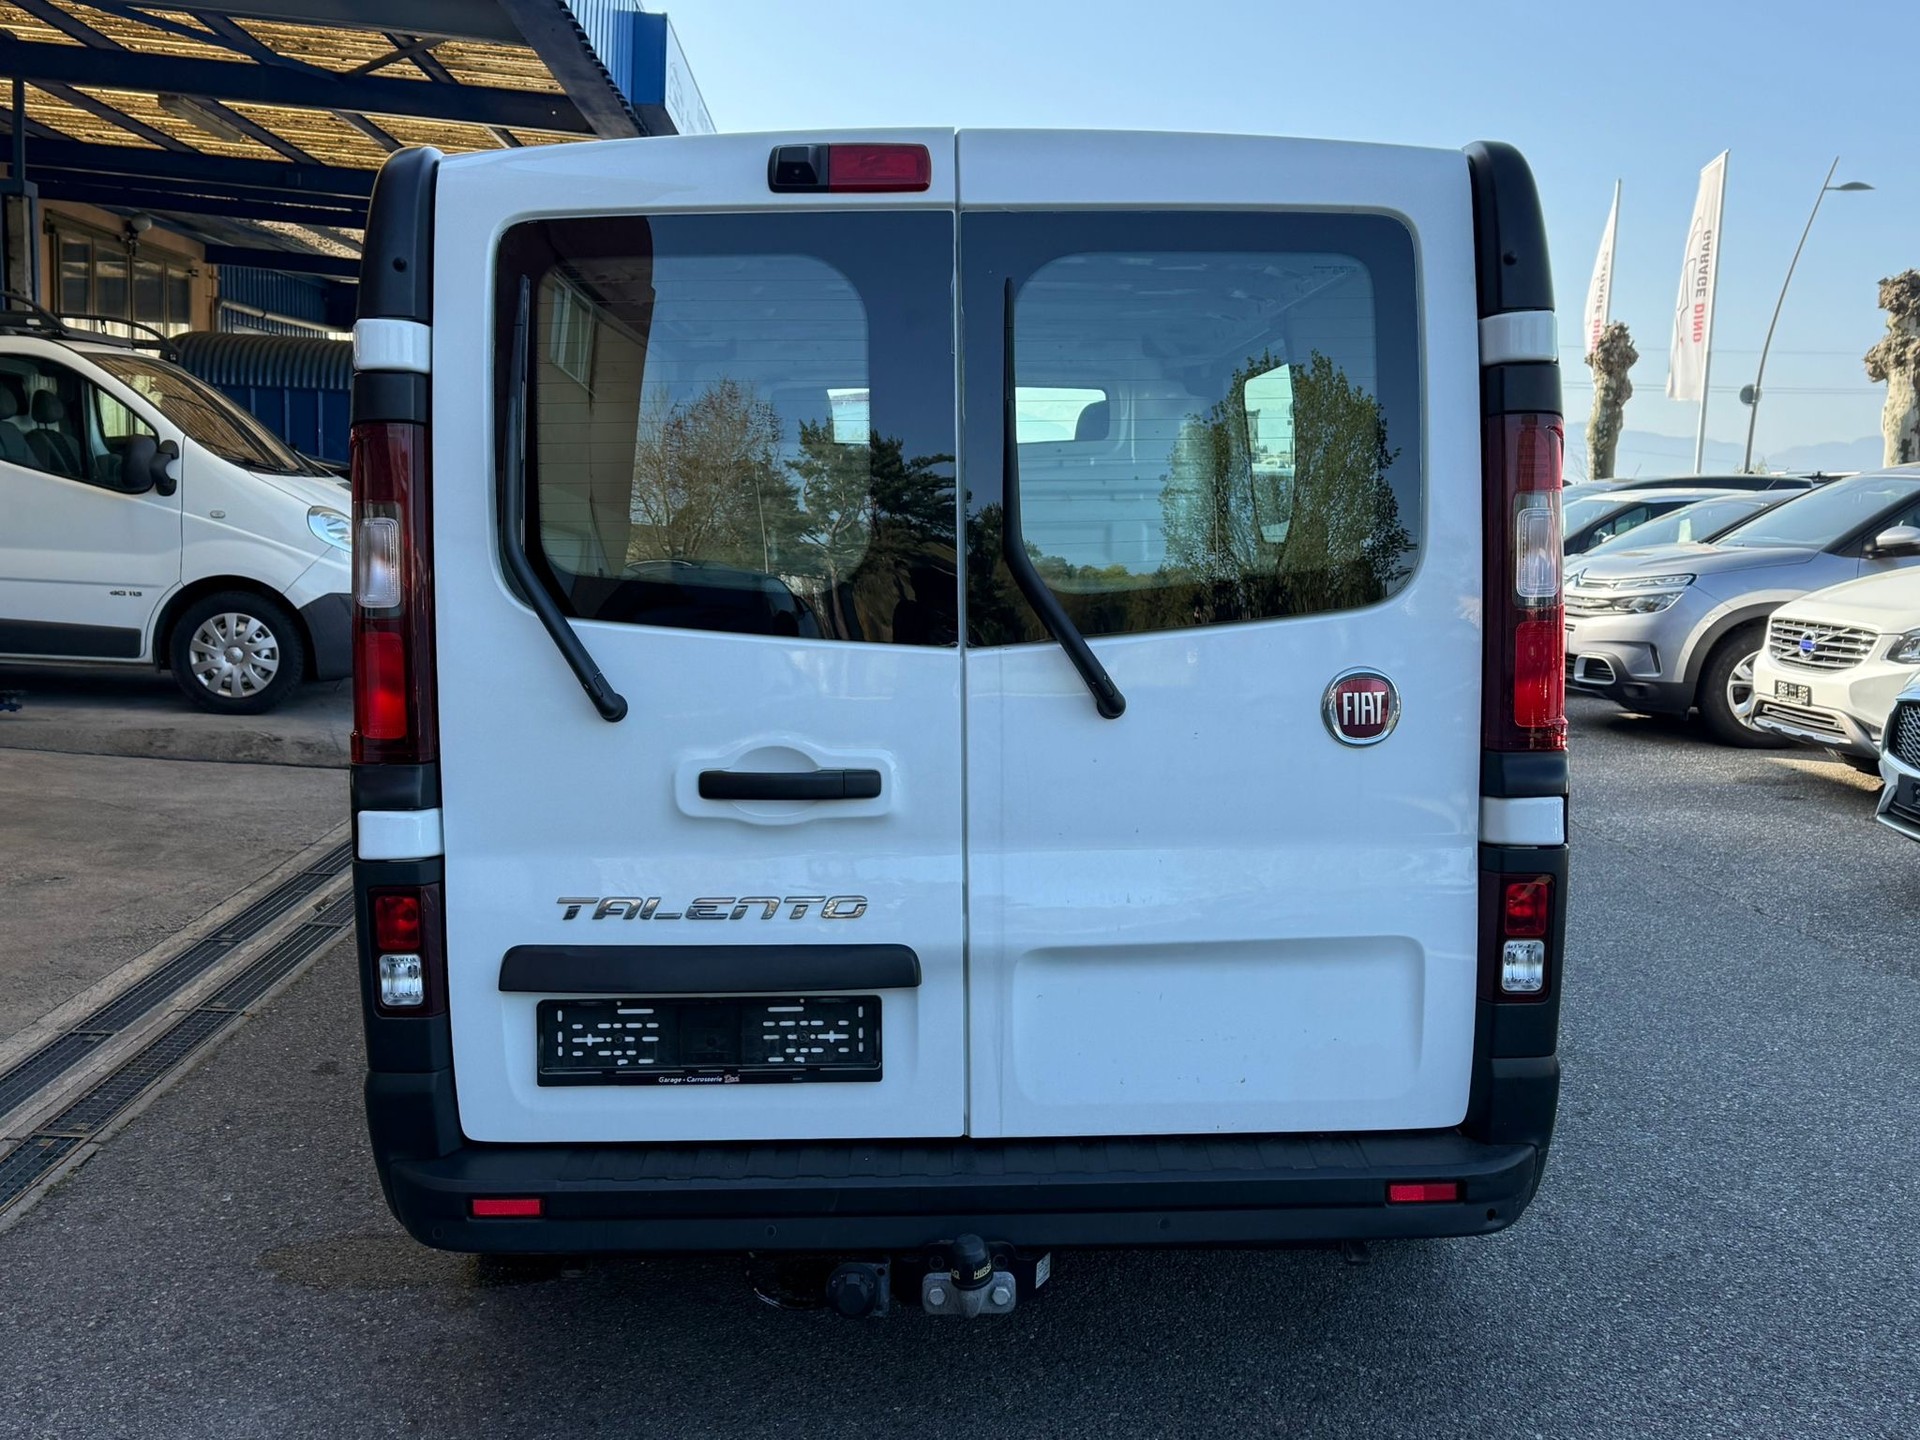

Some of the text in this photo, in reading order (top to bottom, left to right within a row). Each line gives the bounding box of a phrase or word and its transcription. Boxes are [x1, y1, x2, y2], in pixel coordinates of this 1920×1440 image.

[1342, 691, 1386, 726] FIAT
[556, 896, 868, 921] TALENTO
[658, 1076, 682, 1084] Garage
[686, 1075, 723, 1083] Carrosserie
